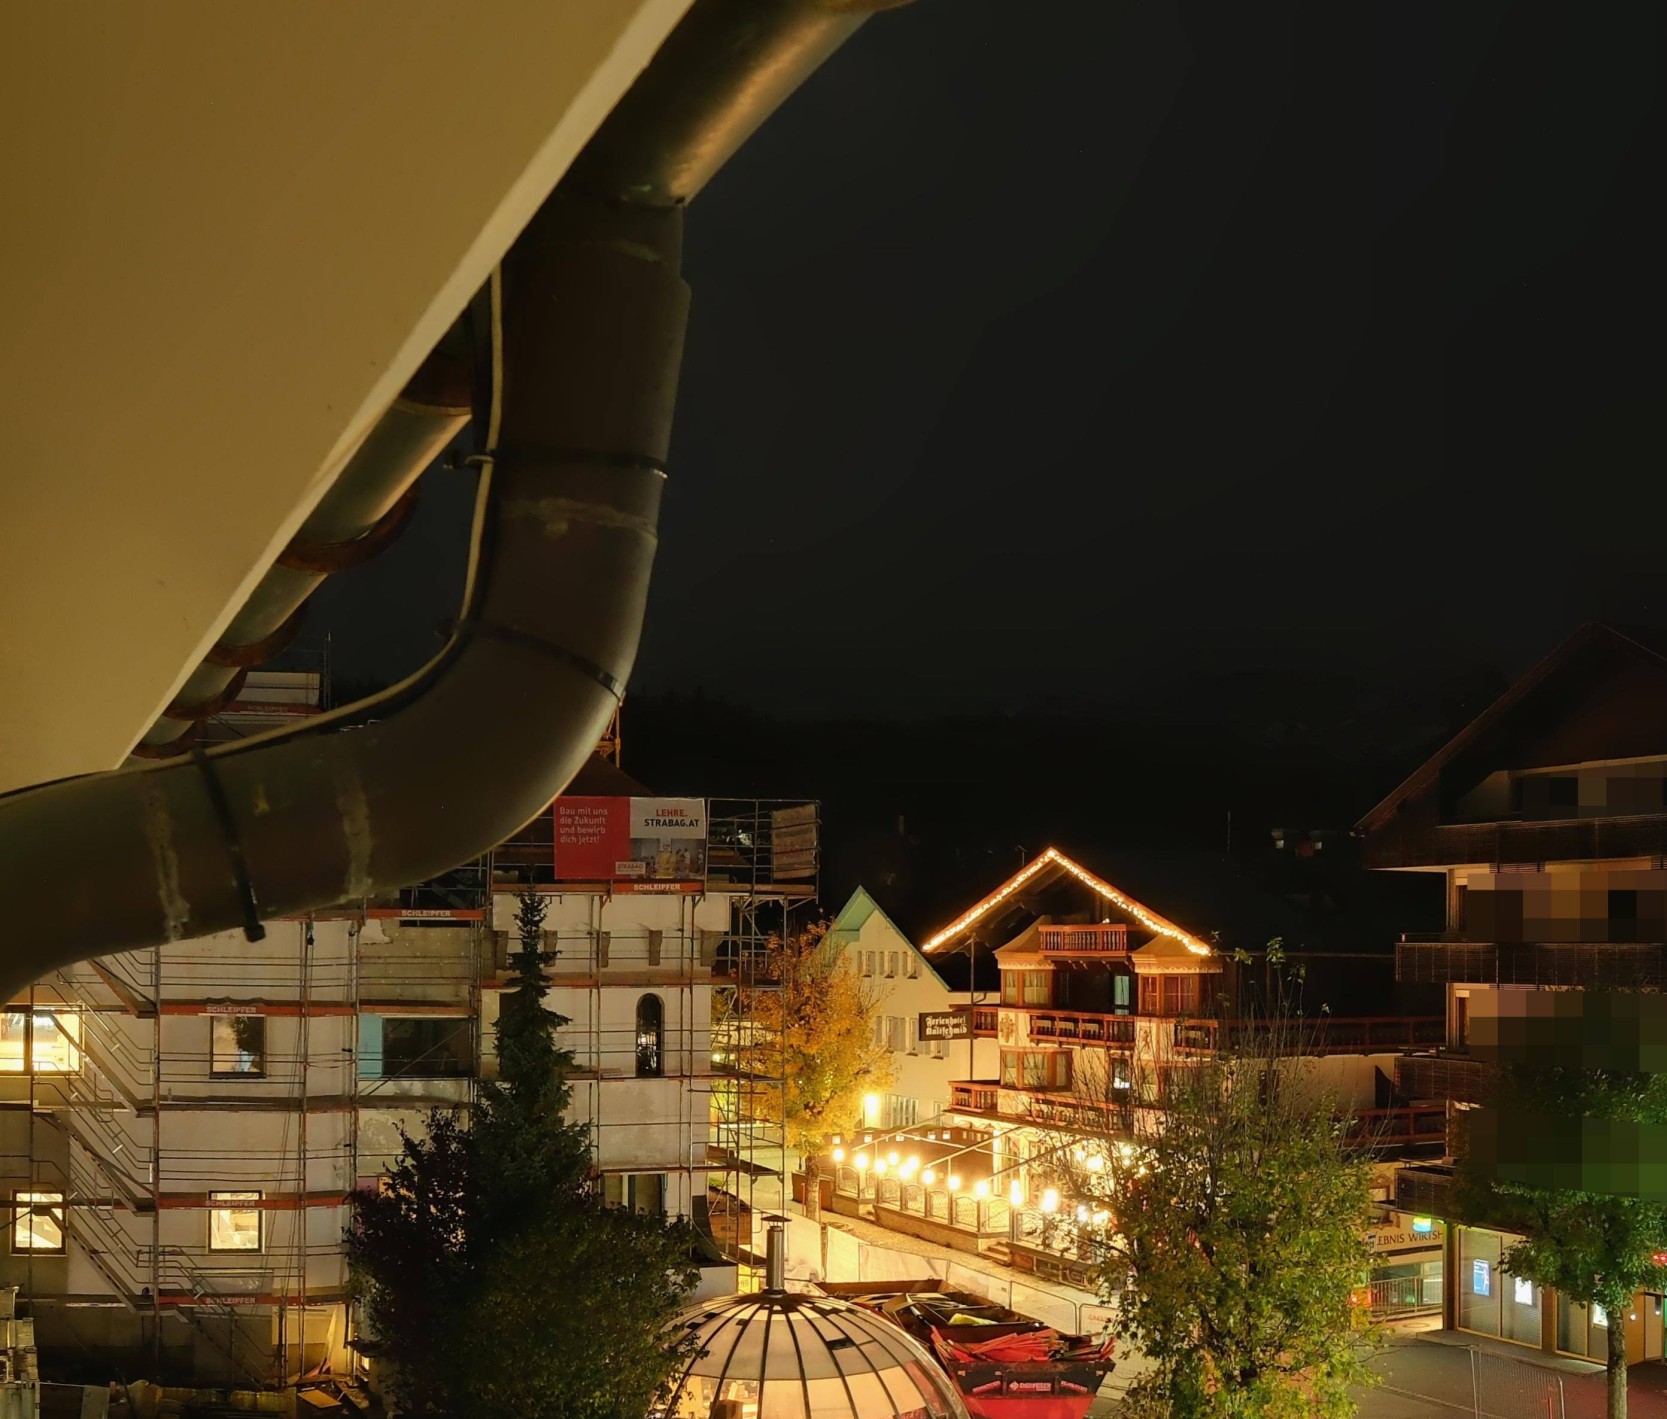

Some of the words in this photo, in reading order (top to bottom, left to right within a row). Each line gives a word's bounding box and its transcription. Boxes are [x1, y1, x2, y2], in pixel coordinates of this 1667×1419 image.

[560, 807, 574, 815] Bau
[578, 807, 591, 815] mit
[593, 807, 608, 815] uns
[656, 809, 688, 817] LEHRE.
[560, 816, 571, 825] die
[575, 816, 606, 825] Zukunft
[644, 818, 700, 828] STRABAG.AT
[560, 826, 574, 834] und
[577, 826, 606, 834] bewirb
[560, 836, 576, 844] dich
[578, 836, 600, 845] jetzt!
[401, 909, 451, 917] SCHLEIPFER
[206, 1006, 256, 1014] SCHLEIPFER
[205, 1297, 256, 1305] SCHLEIPFER
